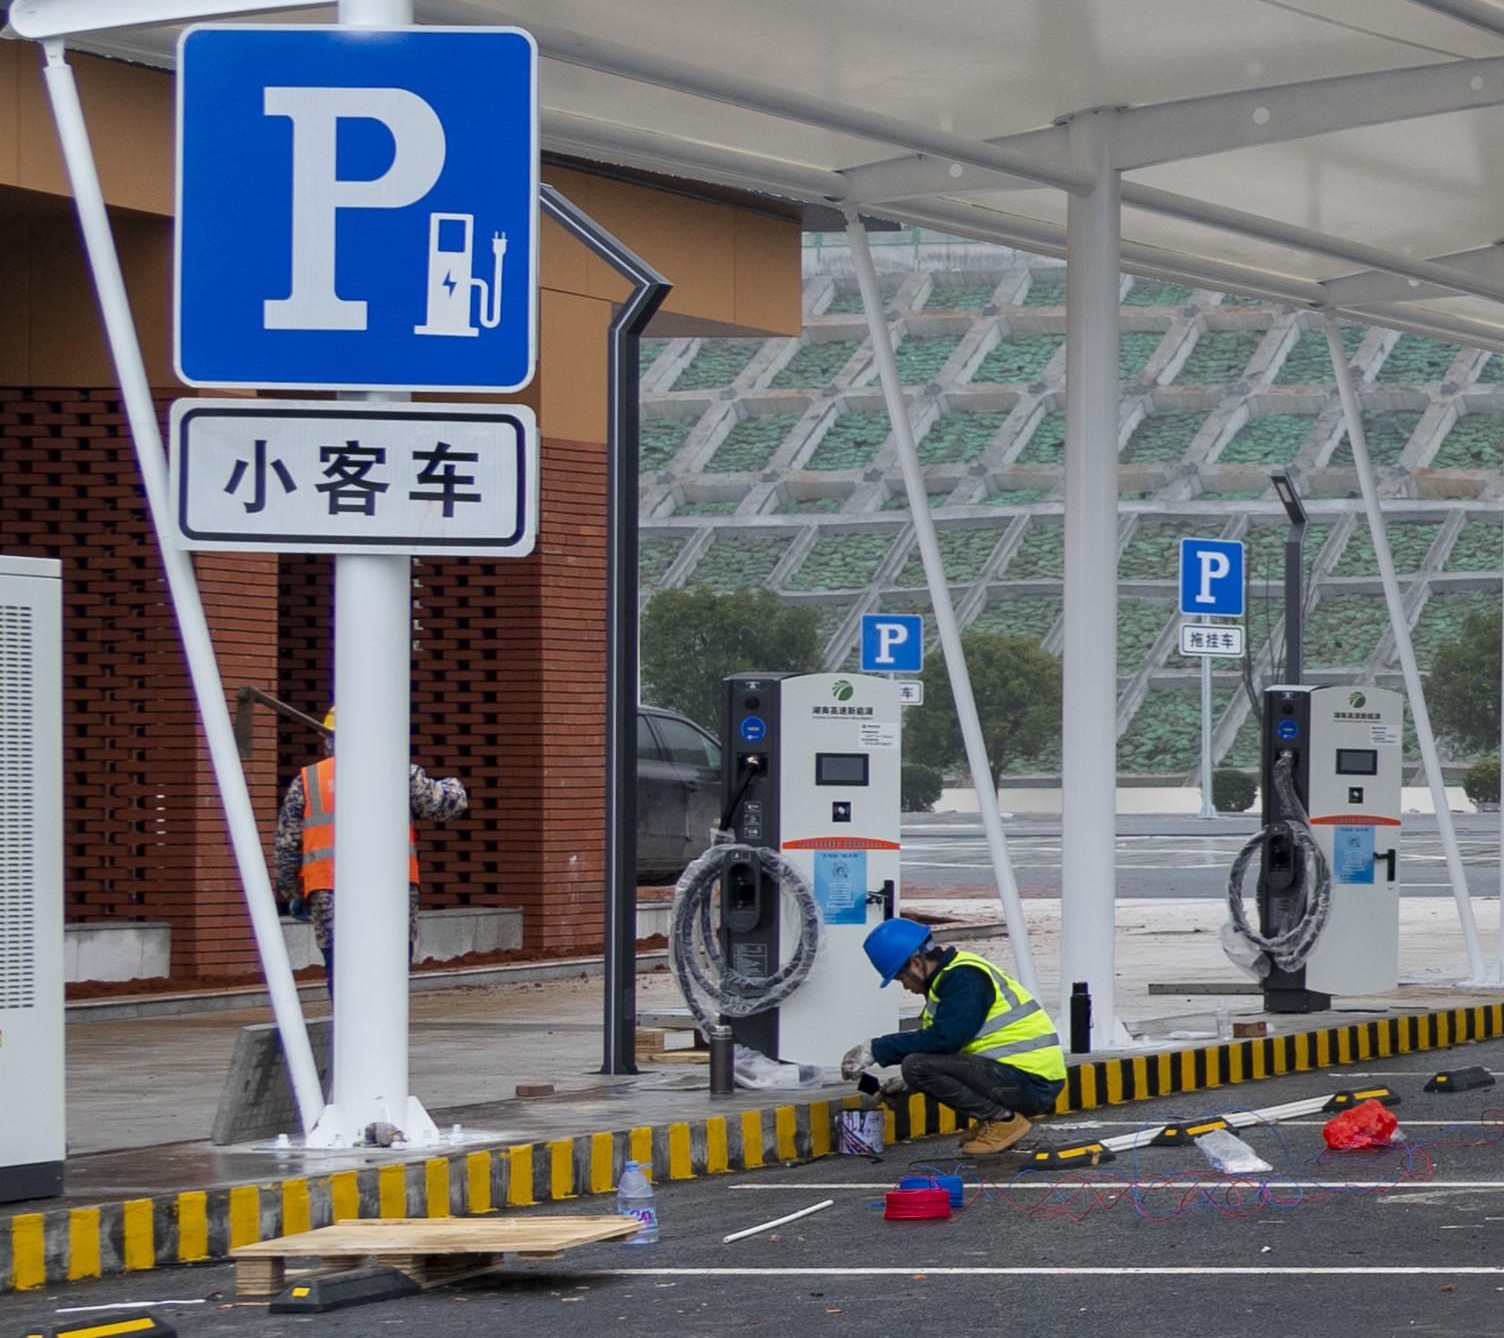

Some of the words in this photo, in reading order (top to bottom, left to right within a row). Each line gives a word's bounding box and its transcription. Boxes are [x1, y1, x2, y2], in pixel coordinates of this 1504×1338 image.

[263, 86, 446, 331] P
[224, 439, 482, 518] 小客车
[1195, 550, 1230, 604] P
[875, 623, 909, 664] P
[1190, 631, 1234, 649] 拖挂车
